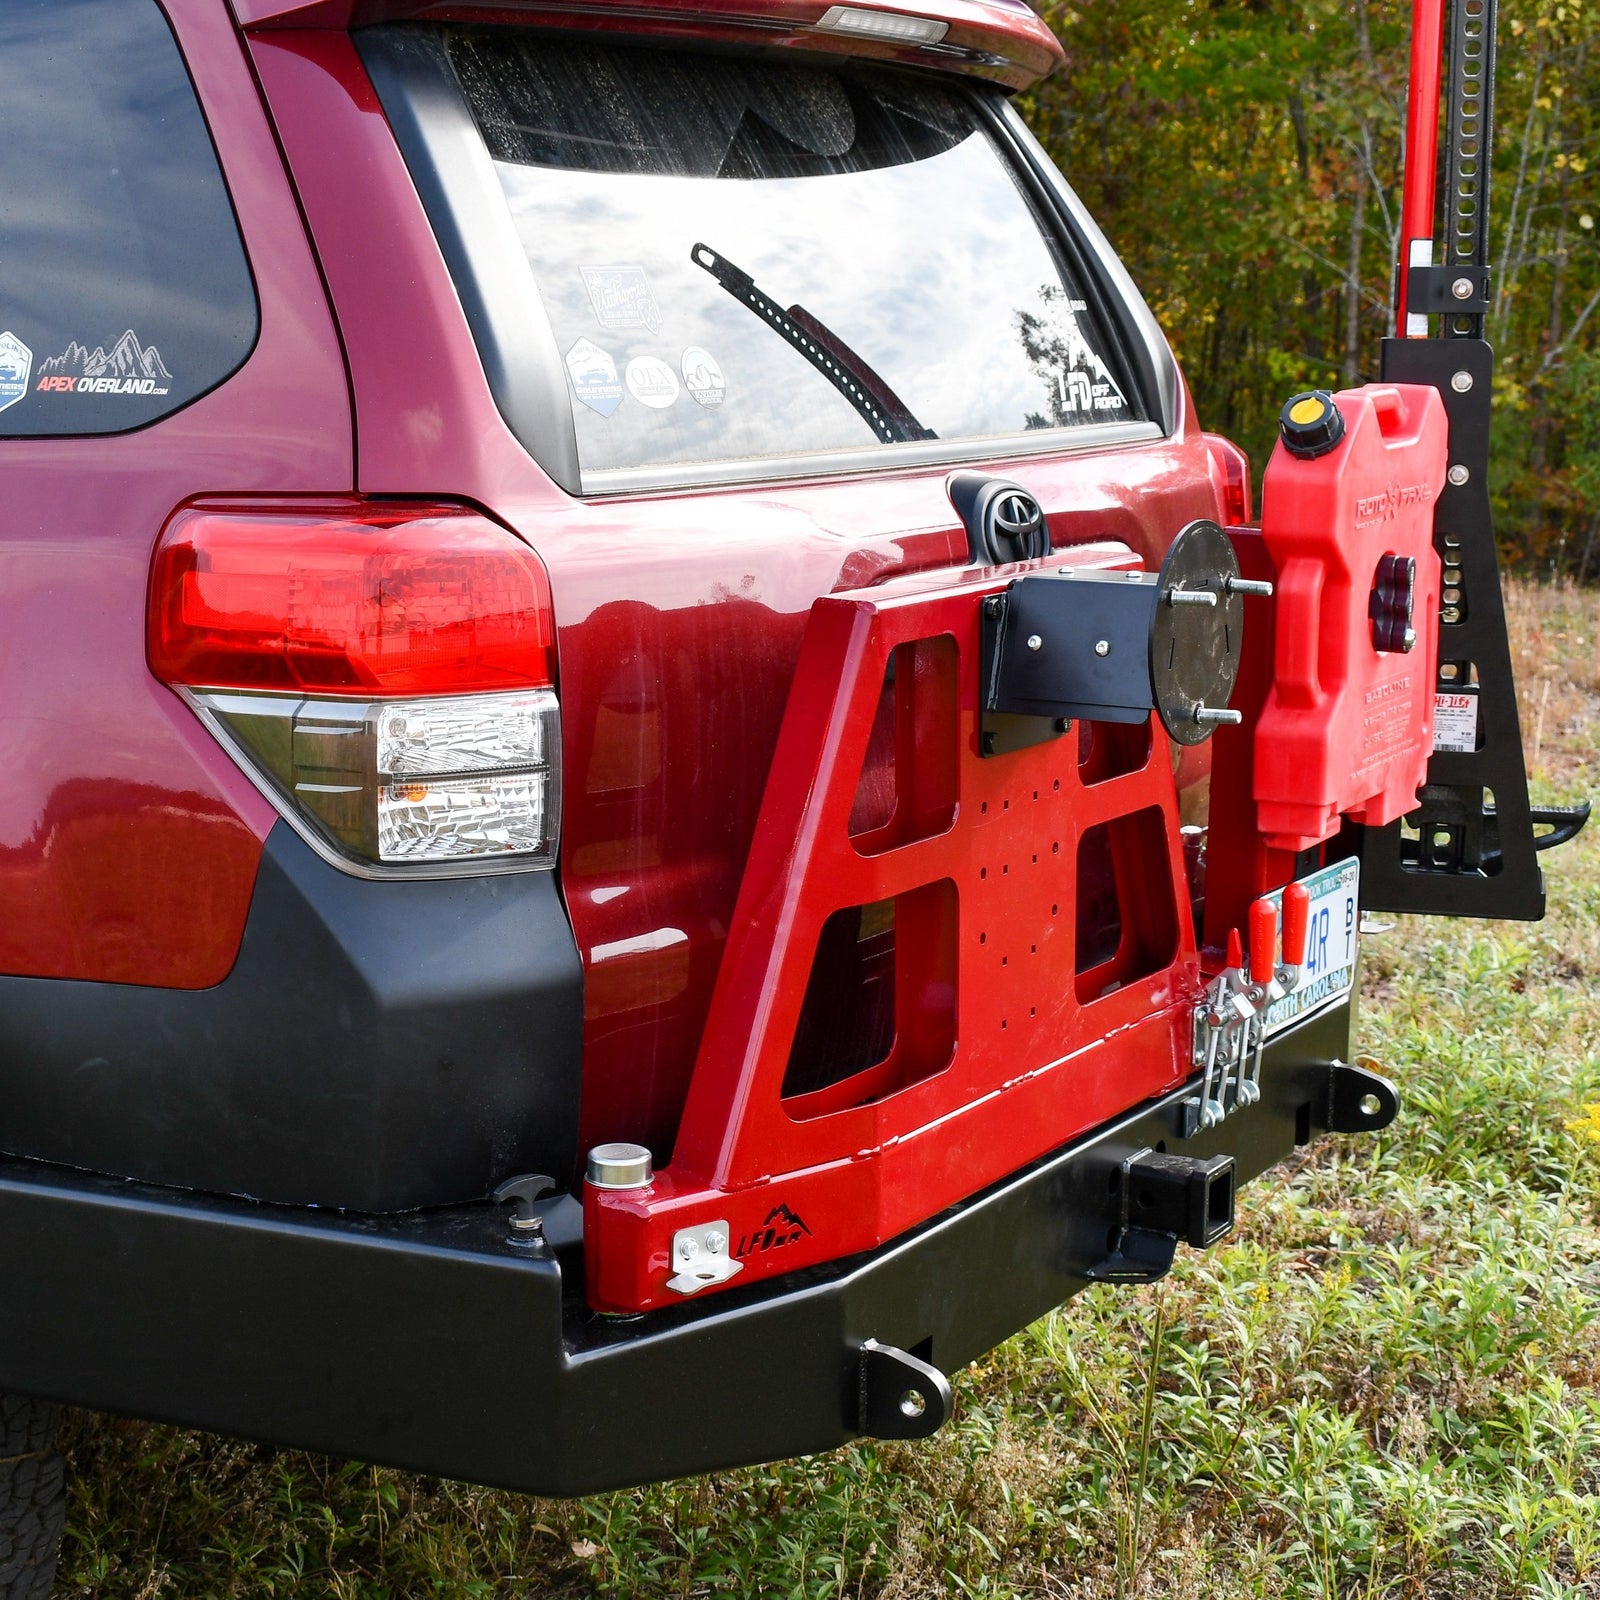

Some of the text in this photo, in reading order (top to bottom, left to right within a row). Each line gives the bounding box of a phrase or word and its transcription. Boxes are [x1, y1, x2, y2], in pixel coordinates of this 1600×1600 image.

[0, 343, 23, 357] OLINA
[37, 376, 78, 392] APEX
[631, 367, 672, 386] OEX
[1091, 383, 1110, 397] OFF
[1093, 395, 1122, 410] ROAD
[1306, 907, 1329, 976] 4R
[1266, 993, 1299, 1026] ORTH
